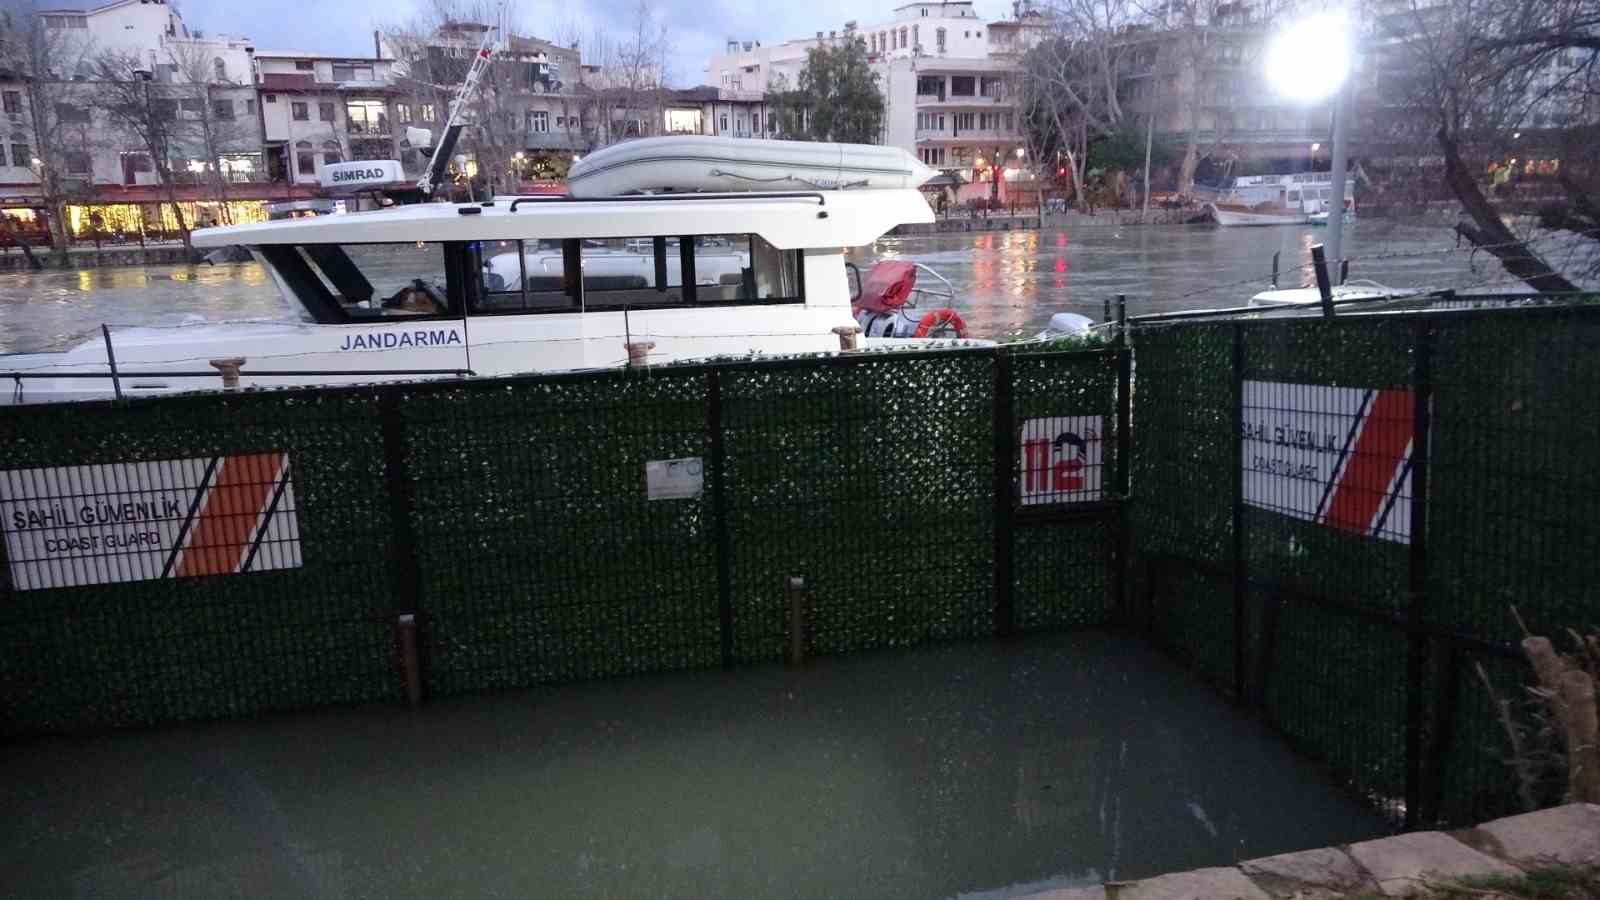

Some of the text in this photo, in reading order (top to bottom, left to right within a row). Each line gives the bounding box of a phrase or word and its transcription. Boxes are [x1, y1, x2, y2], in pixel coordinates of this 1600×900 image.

[332, 168, 385, 183] SIMRAD
[341, 330, 461, 350] JANDARMA
[46, 531, 161, 553] COAST GUARD
